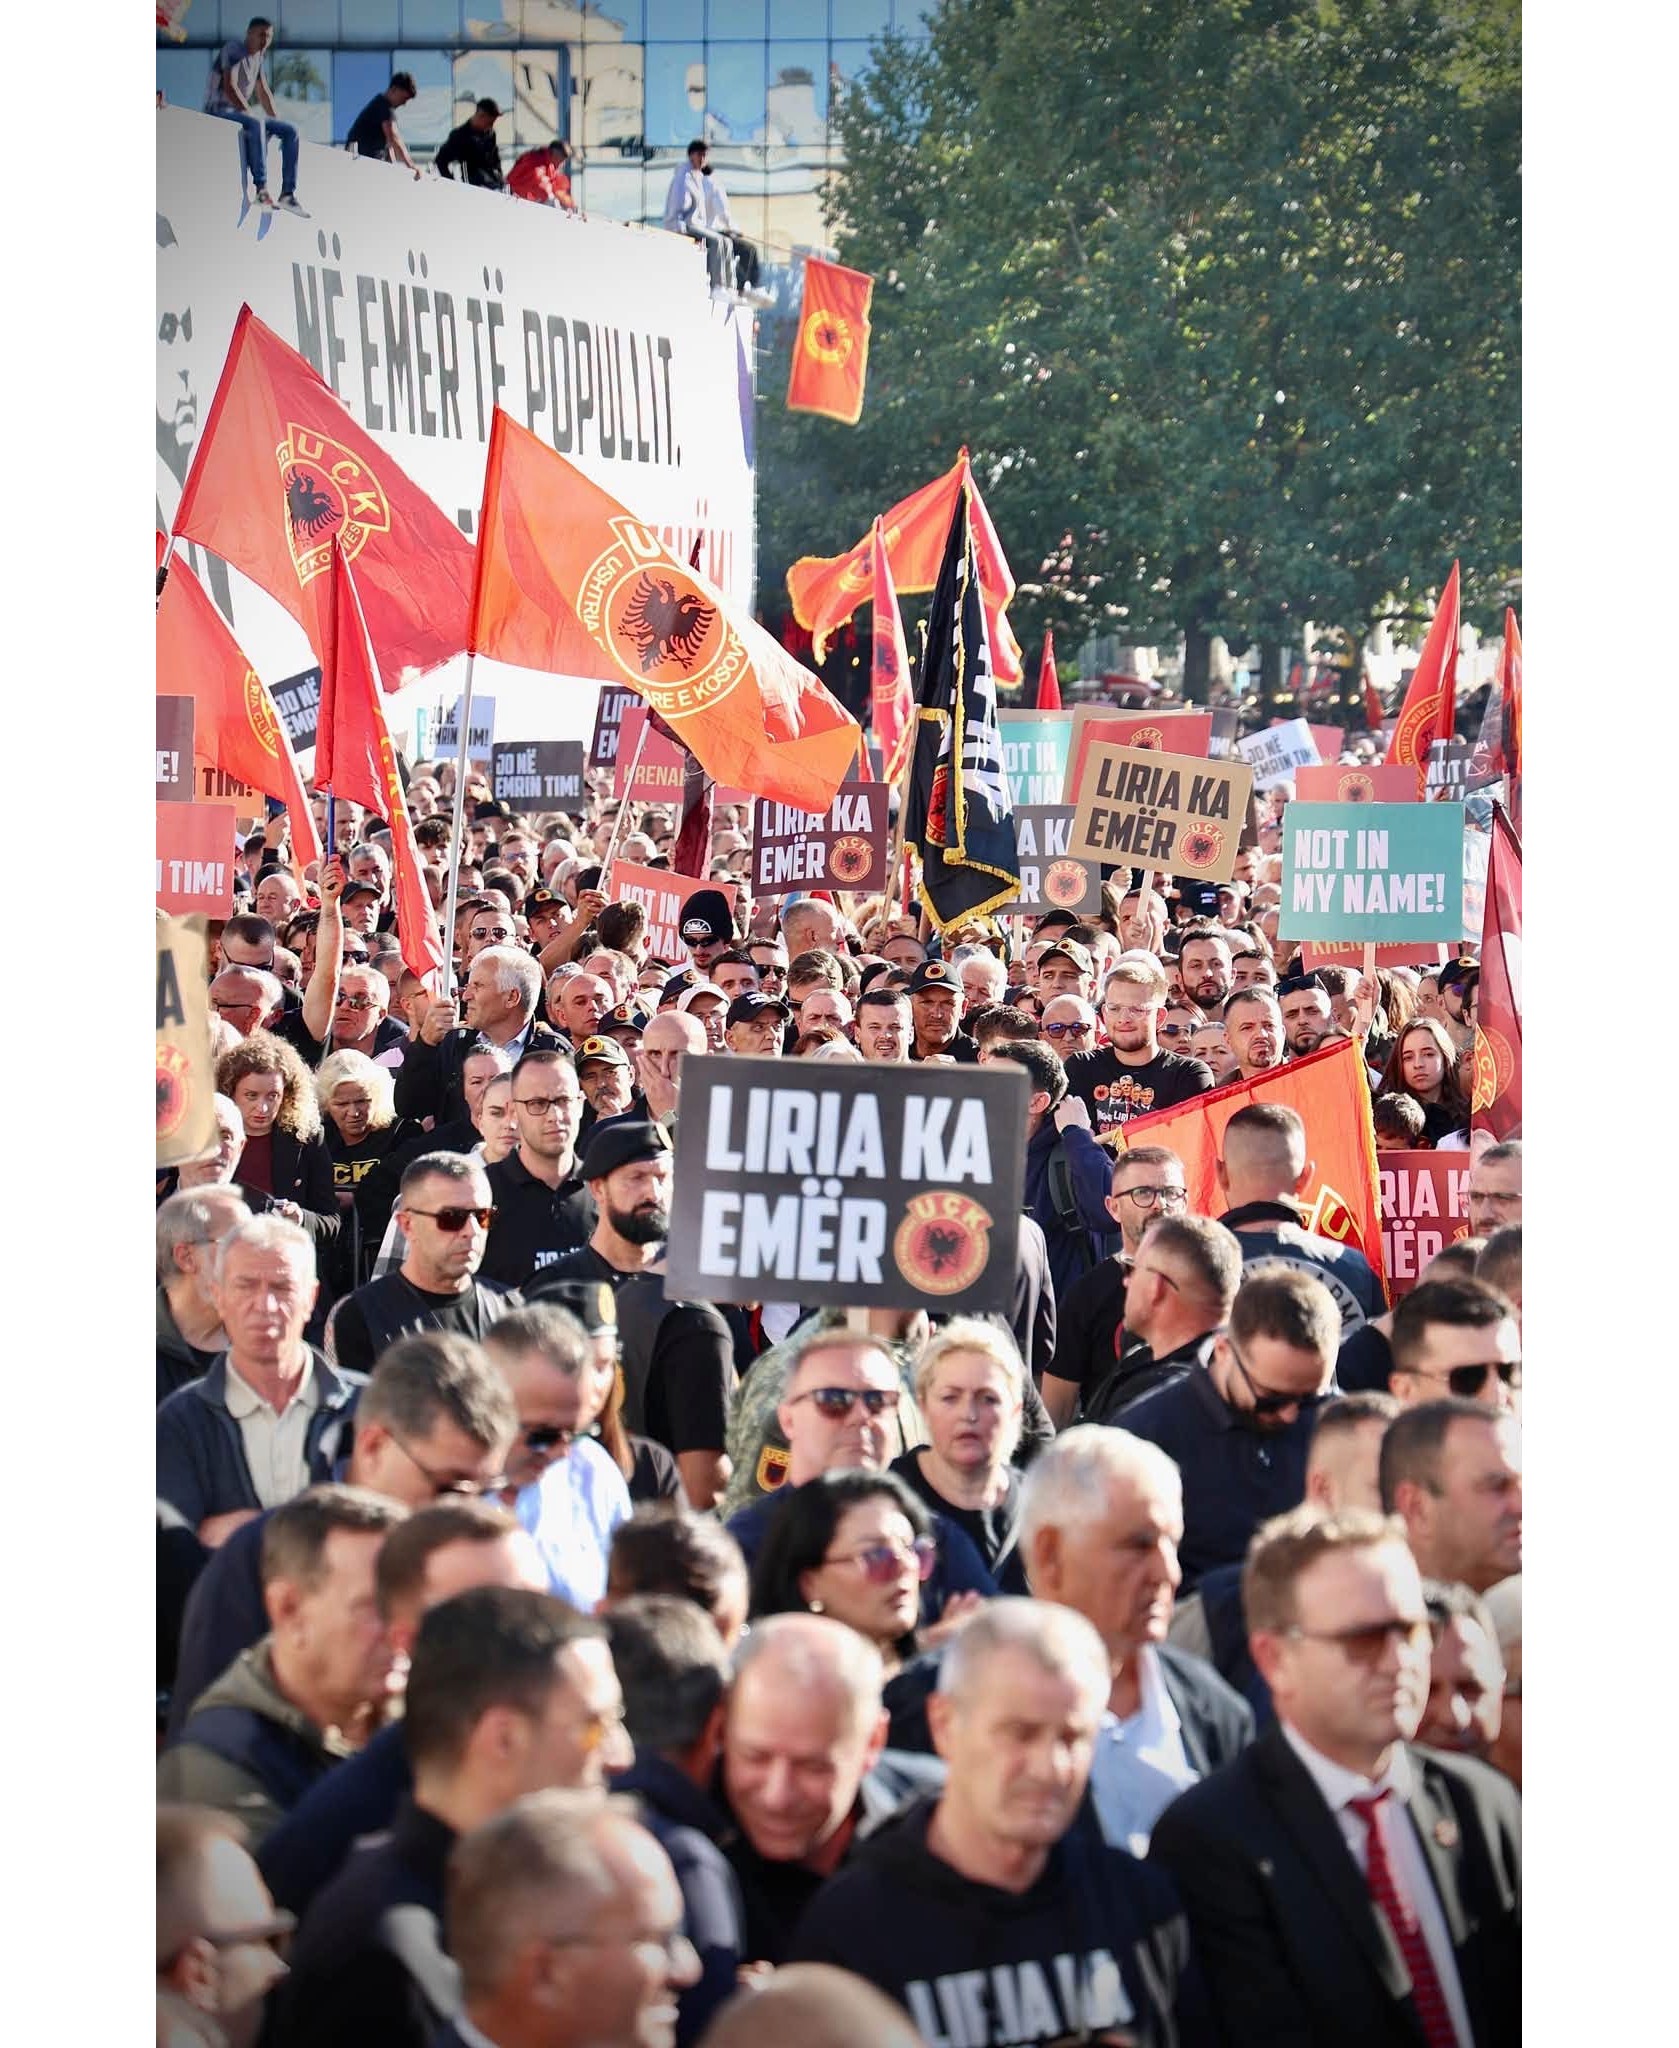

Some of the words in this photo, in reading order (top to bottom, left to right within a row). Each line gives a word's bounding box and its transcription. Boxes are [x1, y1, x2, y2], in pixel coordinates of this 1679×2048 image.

[356, 250, 463, 440] EMËR
[467, 265, 506, 442] TË
[522, 308, 681, 467] POPULLIT.
[284, 705, 321, 739] EMR
[467, 727, 489, 746] IM!
[495, 753, 513, 776] JO
[516, 748, 537, 775] NË
[1005, 741, 1033, 773] OT
[1035, 741, 1058, 772] IN
[495, 775, 541, 799] EMRIN
[544, 774, 580, 797] TIM!
[1096, 757, 1181, 811] LIRIA
[1186, 774, 1231, 820] KA
[761, 799, 825, 838] LIRIA
[831, 794, 873, 833] KA
[1085, 806, 1177, 861] EMËR
[759, 834, 826, 885] EMËR
[1294, 829, 1351, 870] NOT
[1357, 829, 1389, 870] IN
[169, 860, 225, 896] TIM!
[1293, 874, 1337, 913] MY
[1343, 873, 1446, 914] NAME!
[658, 891, 681, 926] IN
[648, 923, 689, 961] NAM
[706, 1084, 886, 1180] LIRIA
[900, 1094, 994, 1185] KA
[1379, 1169, 1440, 1218] RIA
[699, 1177, 888, 1285] EMËR
